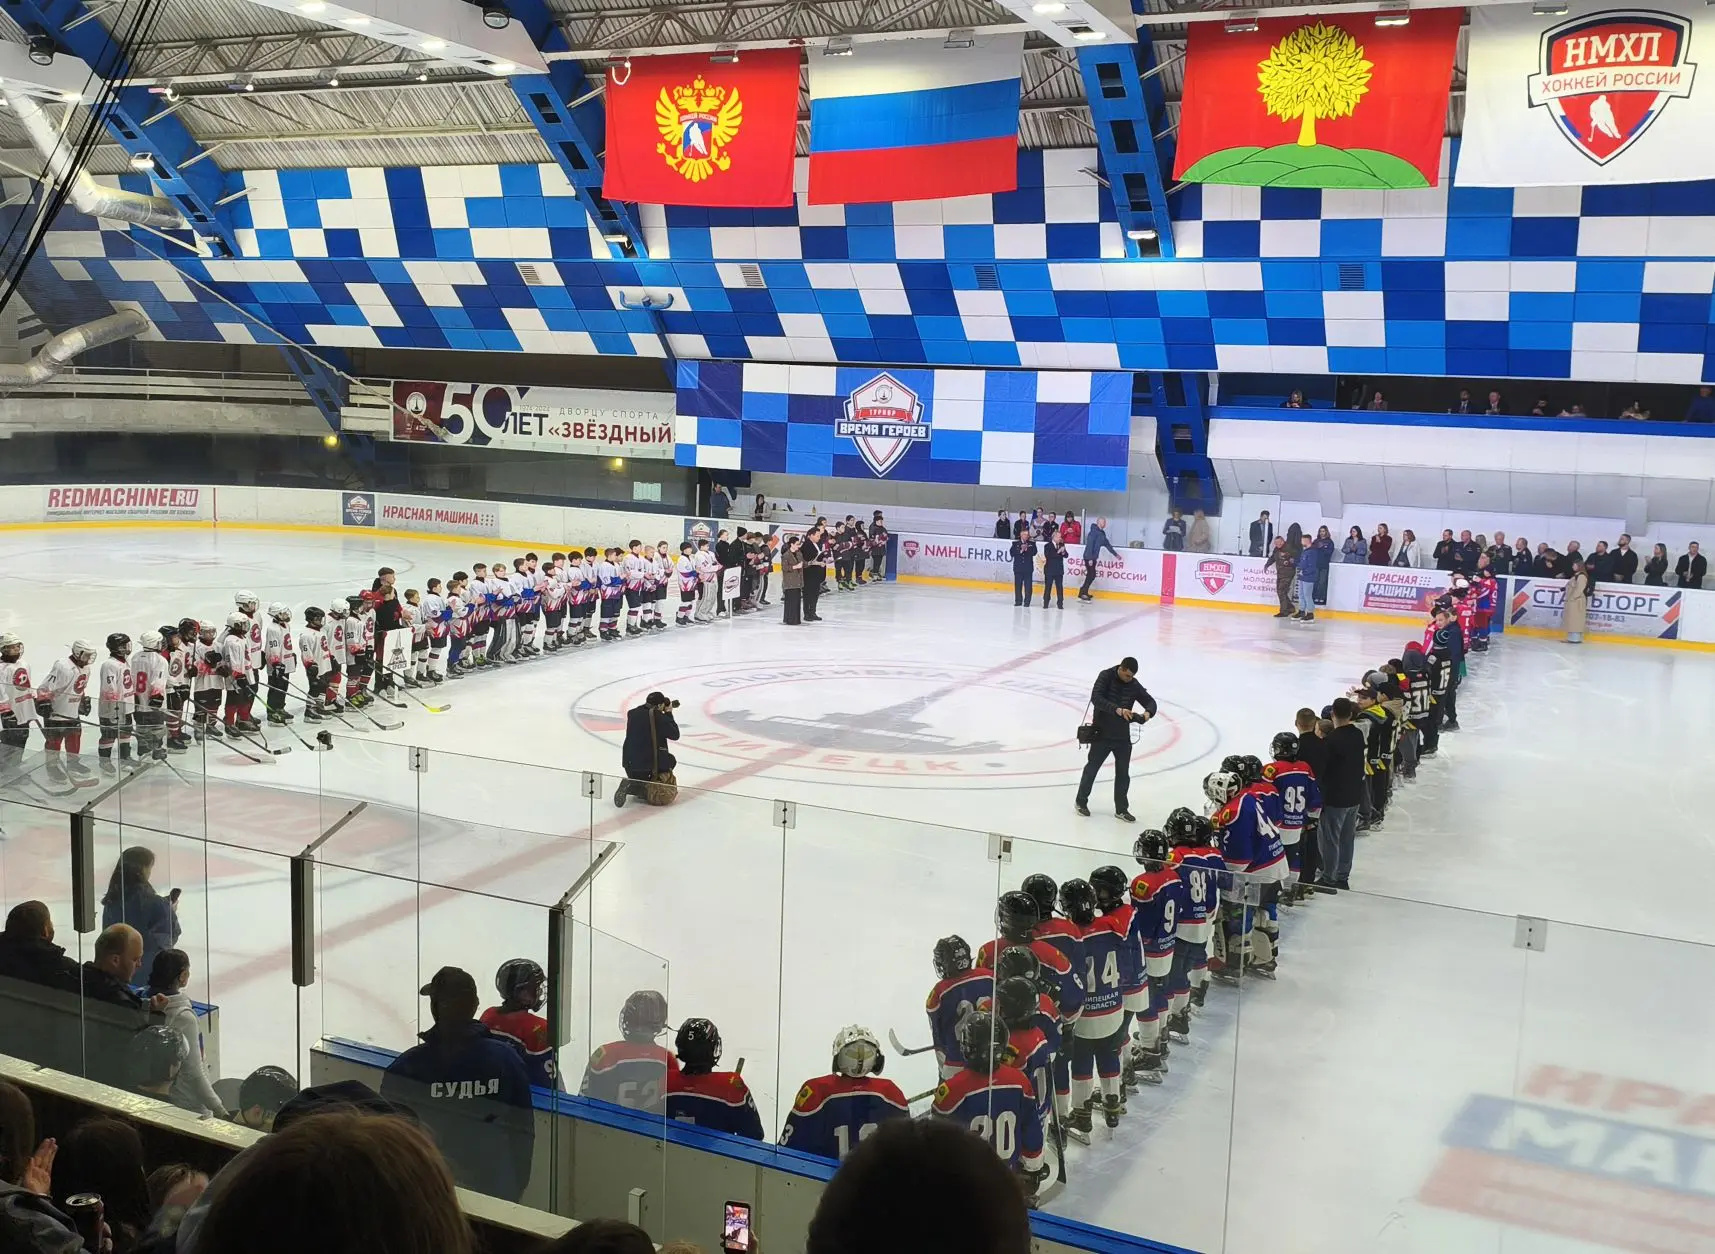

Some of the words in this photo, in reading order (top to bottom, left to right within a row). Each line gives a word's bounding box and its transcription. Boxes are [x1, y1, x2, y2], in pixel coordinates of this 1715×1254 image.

[1563, 32, 1662, 68] НМХЛ
[1542, 72, 1608, 94] ХОККЕЙ
[1613, 71, 1682, 87] РОССИИ
[501, 411, 549, 437] ЛЕТ
[559, 407, 605, 418] ДВОРЦУ
[612, 409, 659, 420] СПОРТА
[840, 422, 879, 435] ВРЕМЯ
[882, 424, 927, 437] ГЕРОЕВ
[47, 487, 199, 508] REDMACHINE.RU
[382, 505, 433, 521] КРАСНАЯ
[435, 511, 479, 526] МАШИНА
[1067, 557, 1124, 569] ФЕДАЦИЯ
[1067, 567, 1105, 578] ХОКЕЯ
[1107, 570, 1147, 582] РОССИИ
[1371, 572, 1418, 585] КРАСНАЯ
[1368, 584, 1417, 598] МАШИНА
[1533, 589, 1660, 612] СТАЬТОРГ
[680, 731, 964, 772] ЛИЕЦК
[1284, 786, 1306, 812] 95
[1081, 901, 1091, 911] 14
[1163, 899, 1175, 933] 9
[1085, 950, 1120, 993] 14
[1085, 1000, 1117, 1011] ОБЛАСТЬ
[687, 1030, 695, 1041] 5
[430, 1078, 500, 1100] СУДЬЯ
[1521, 1063, 1715, 1127] КР
[1488, 1104, 1715, 1191] МА
